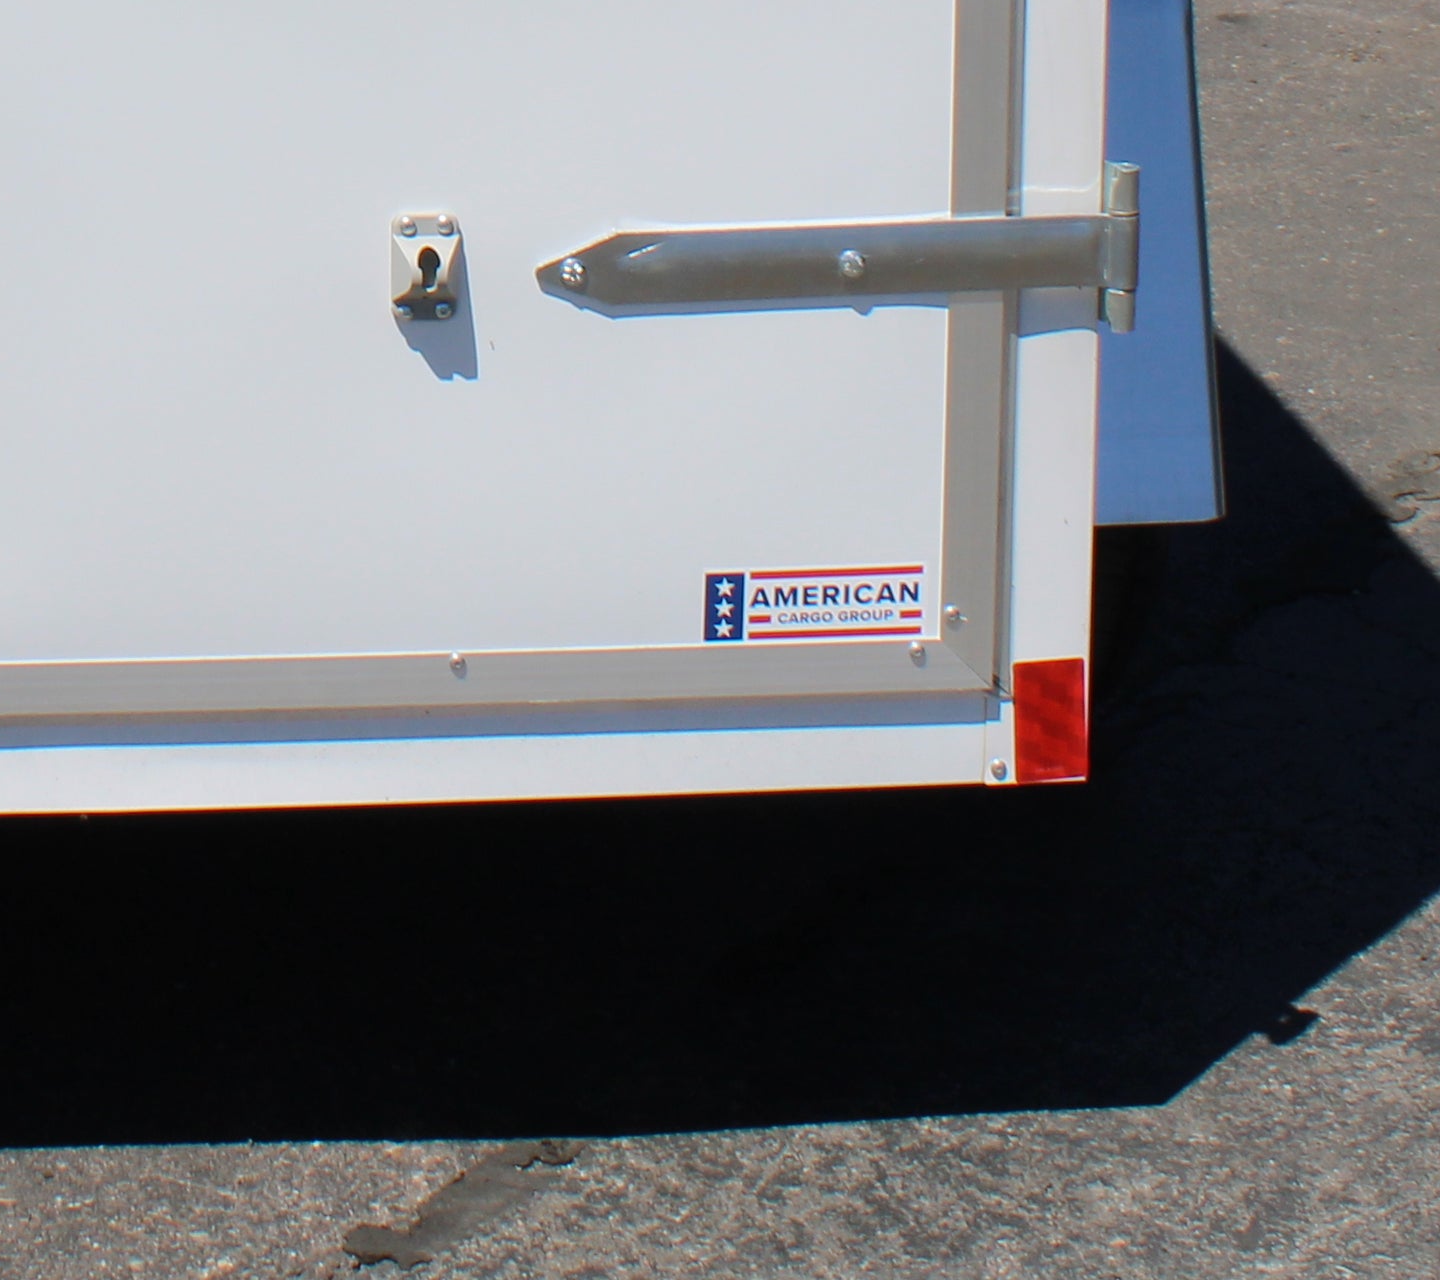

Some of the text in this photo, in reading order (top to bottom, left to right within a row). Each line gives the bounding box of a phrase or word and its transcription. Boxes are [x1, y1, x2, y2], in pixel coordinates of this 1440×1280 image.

[748, 581, 920, 609] AMERICAN
[777, 609, 894, 624] CARGO GROUP
